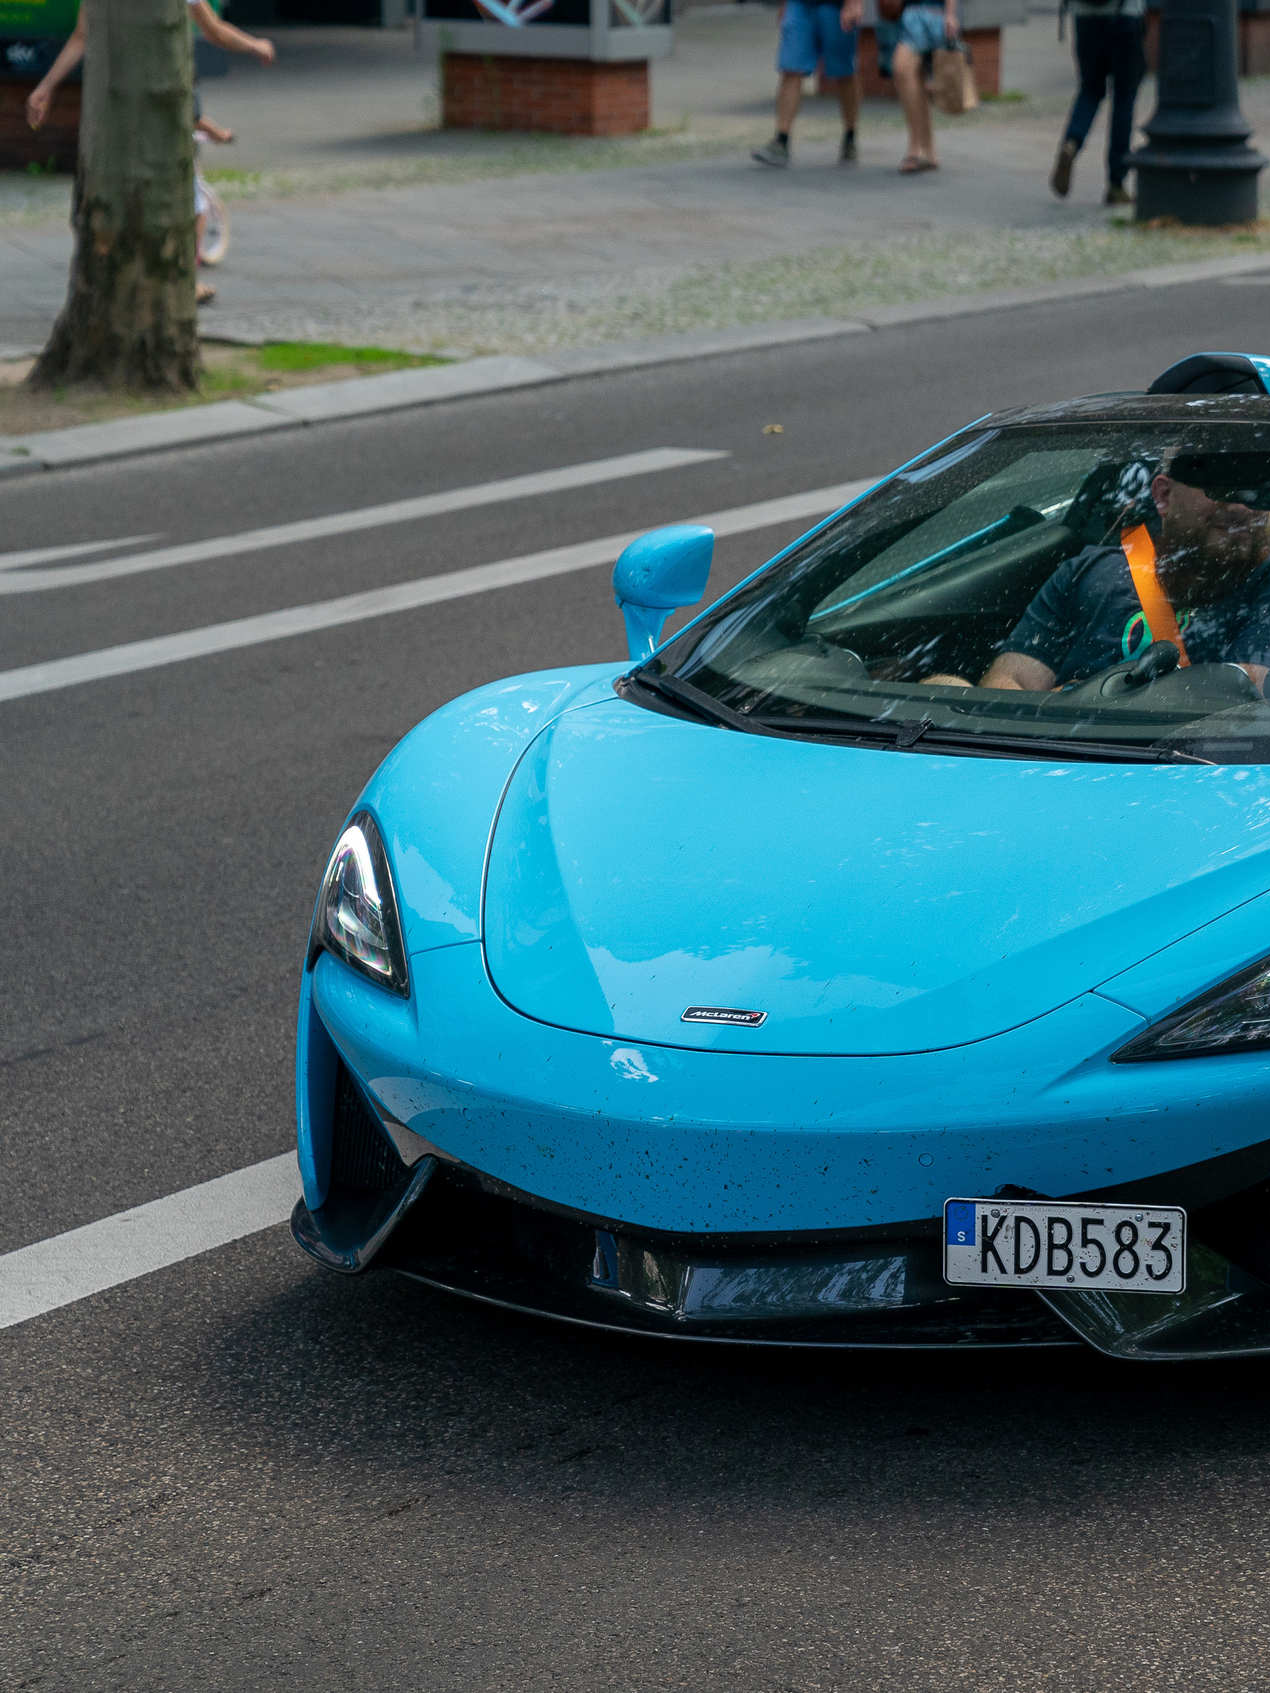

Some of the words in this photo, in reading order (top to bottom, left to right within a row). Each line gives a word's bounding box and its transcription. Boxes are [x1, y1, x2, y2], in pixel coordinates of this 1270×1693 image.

[689, 1010, 751, 1021] McLaren
[957, 1231, 966, 1242] S
[980, 1214, 1173, 1281] KDB583
